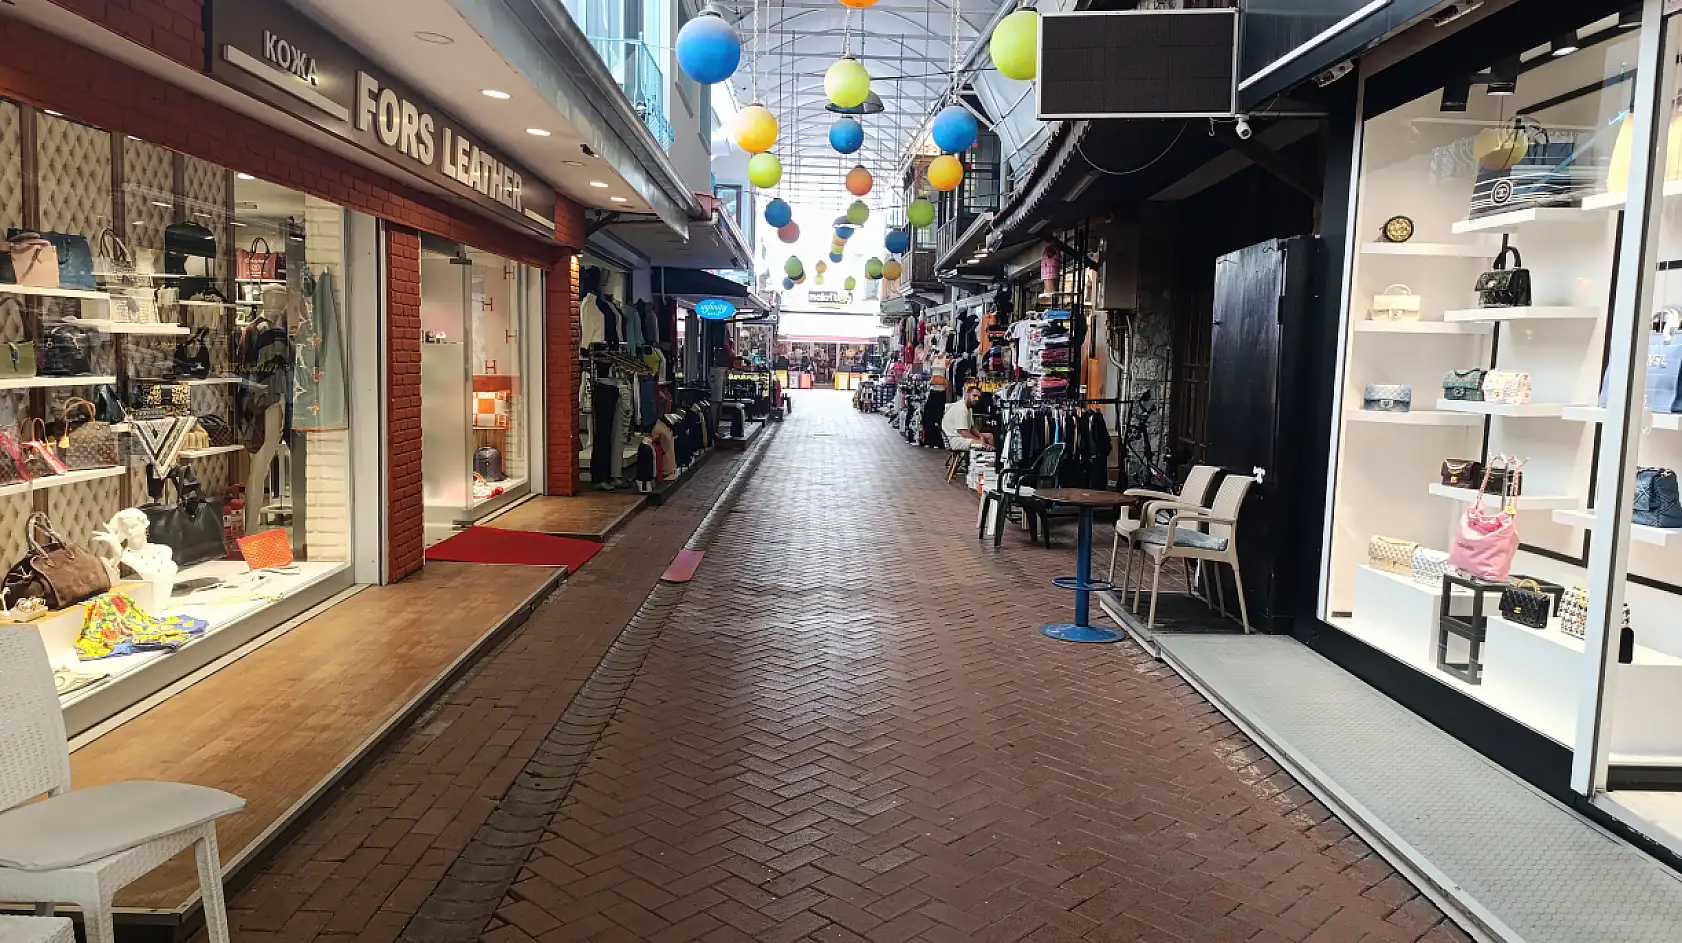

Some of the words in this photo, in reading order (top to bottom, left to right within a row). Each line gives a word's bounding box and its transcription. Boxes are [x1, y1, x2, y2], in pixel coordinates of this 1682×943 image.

[263, 29, 318, 87] КОЖА
[356, 70, 435, 166] FORS
[440, 127, 523, 213] LEATHER
